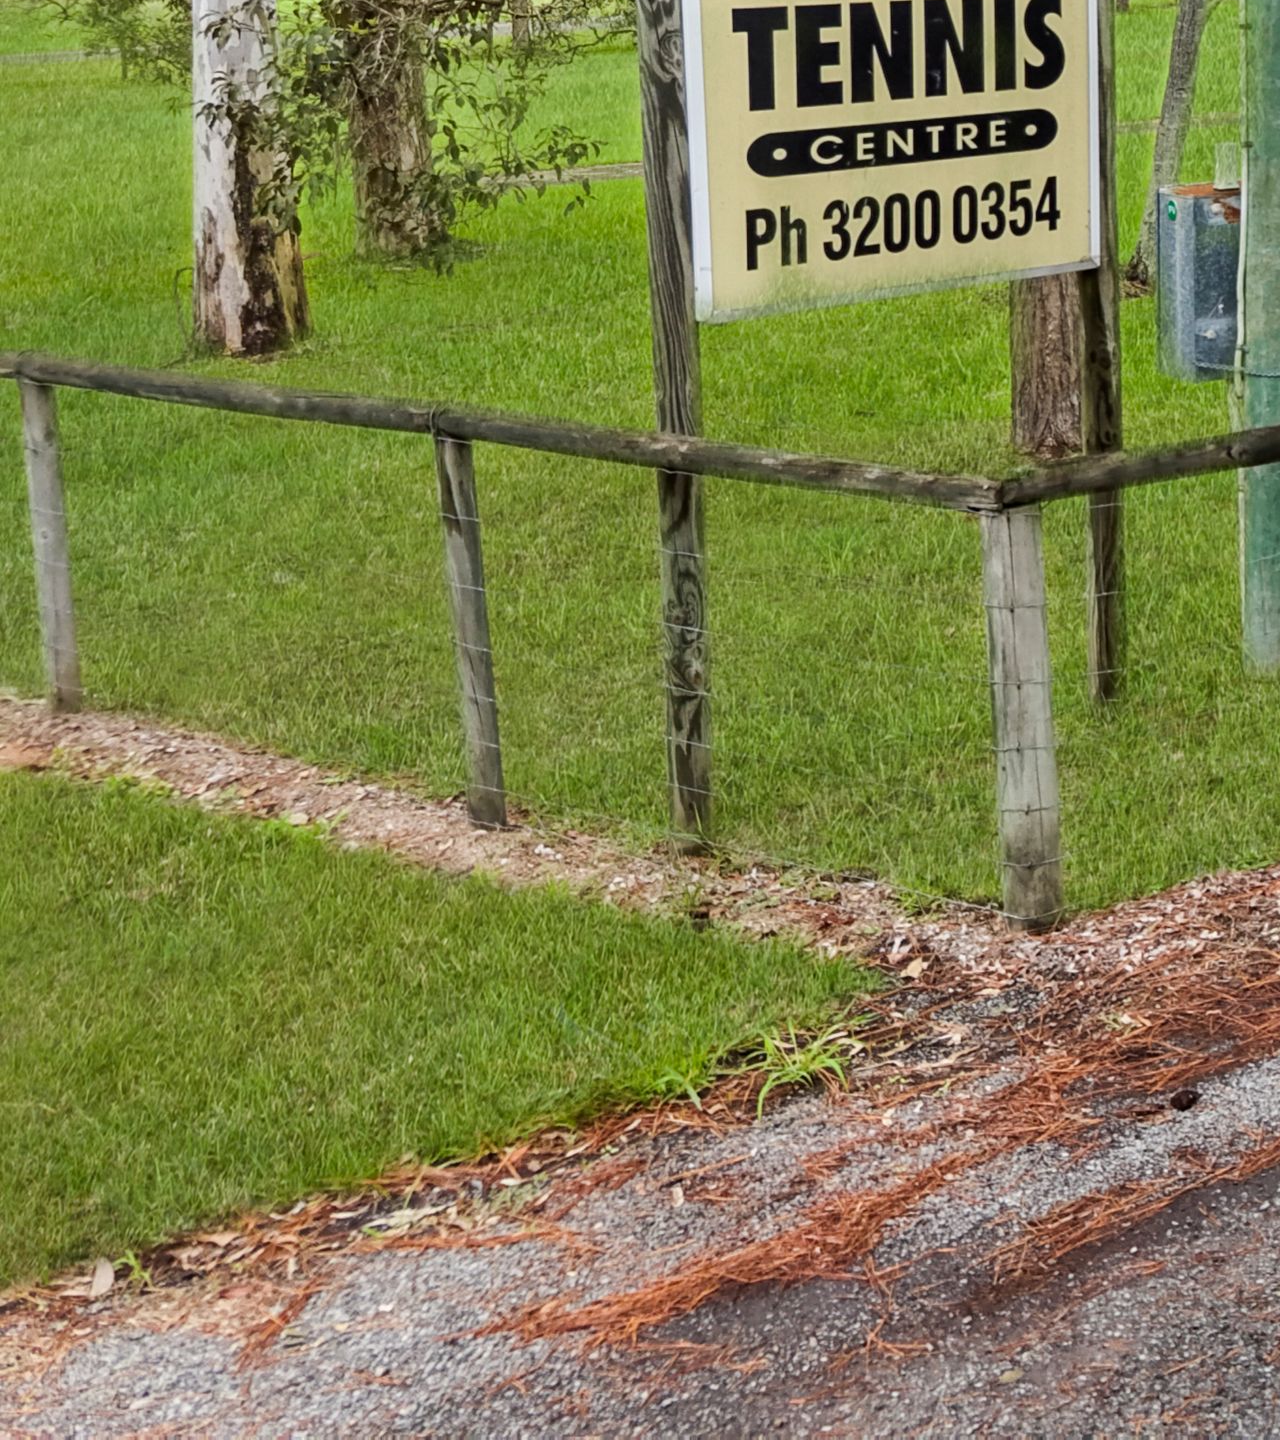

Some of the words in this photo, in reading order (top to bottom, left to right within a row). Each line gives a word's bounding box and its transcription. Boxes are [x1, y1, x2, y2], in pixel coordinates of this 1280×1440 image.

[810, 119, 1006, 165] CENTRE
[745, 205, 808, 271] Ph
[823, 189, 941, 261] 3200
[952, 175, 1061, 244] 0354
